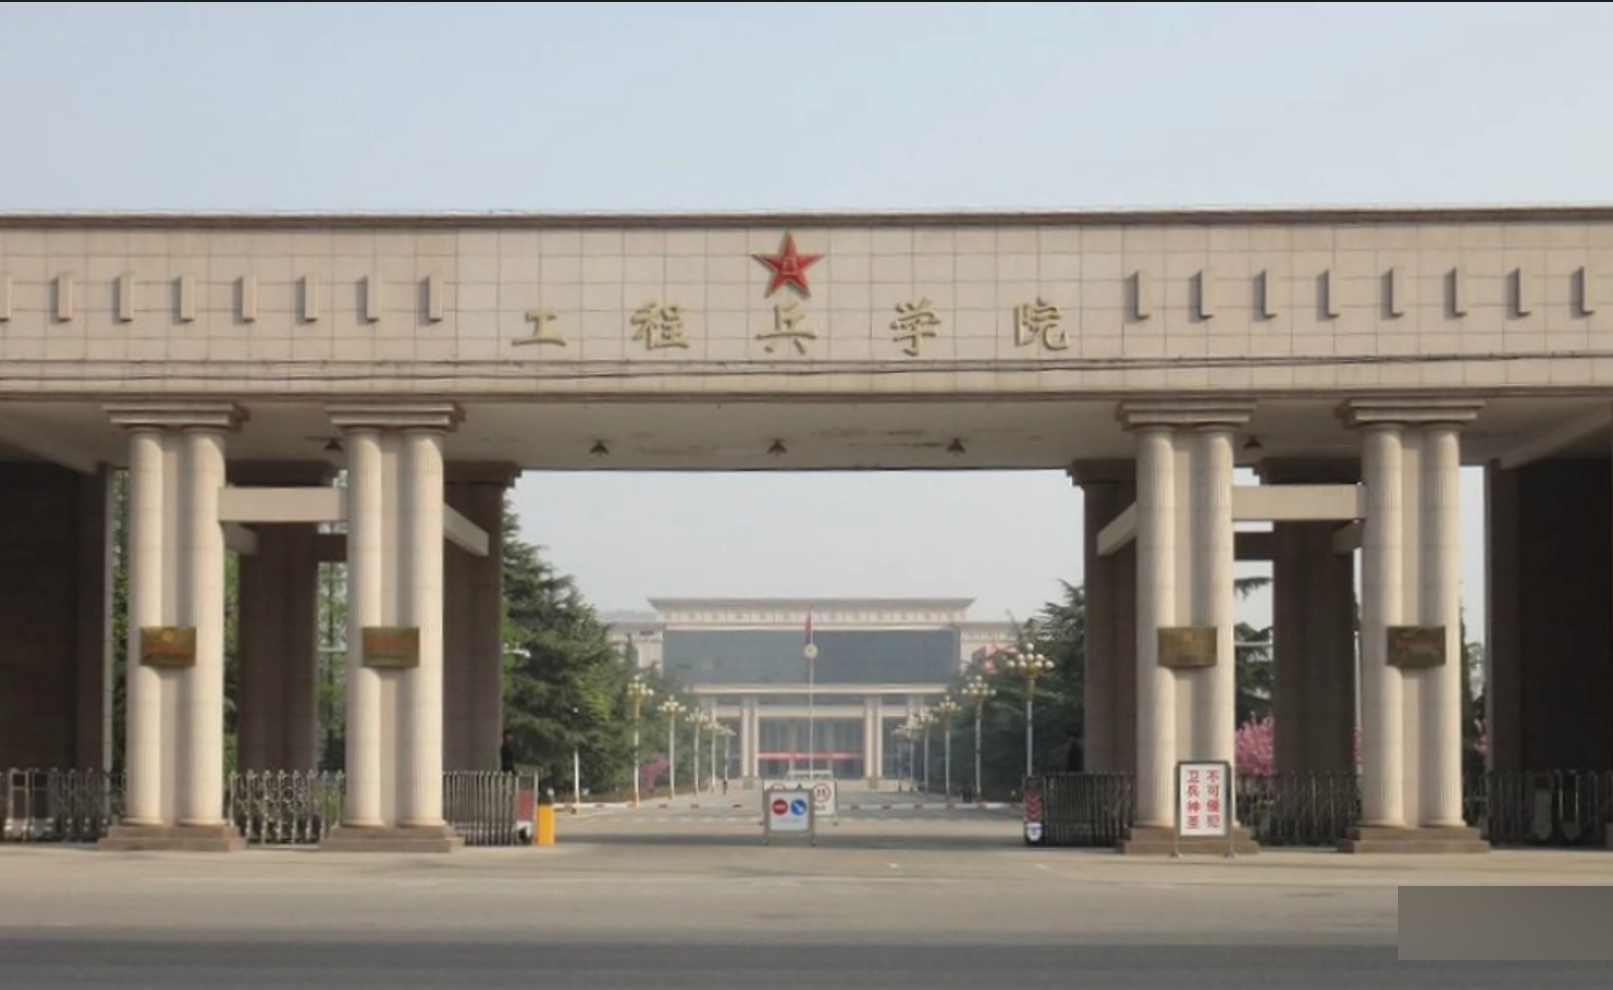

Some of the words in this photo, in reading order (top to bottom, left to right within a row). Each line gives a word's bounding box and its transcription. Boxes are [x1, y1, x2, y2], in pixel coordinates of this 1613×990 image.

[511, 298, 1071, 356] 工程兵学院
